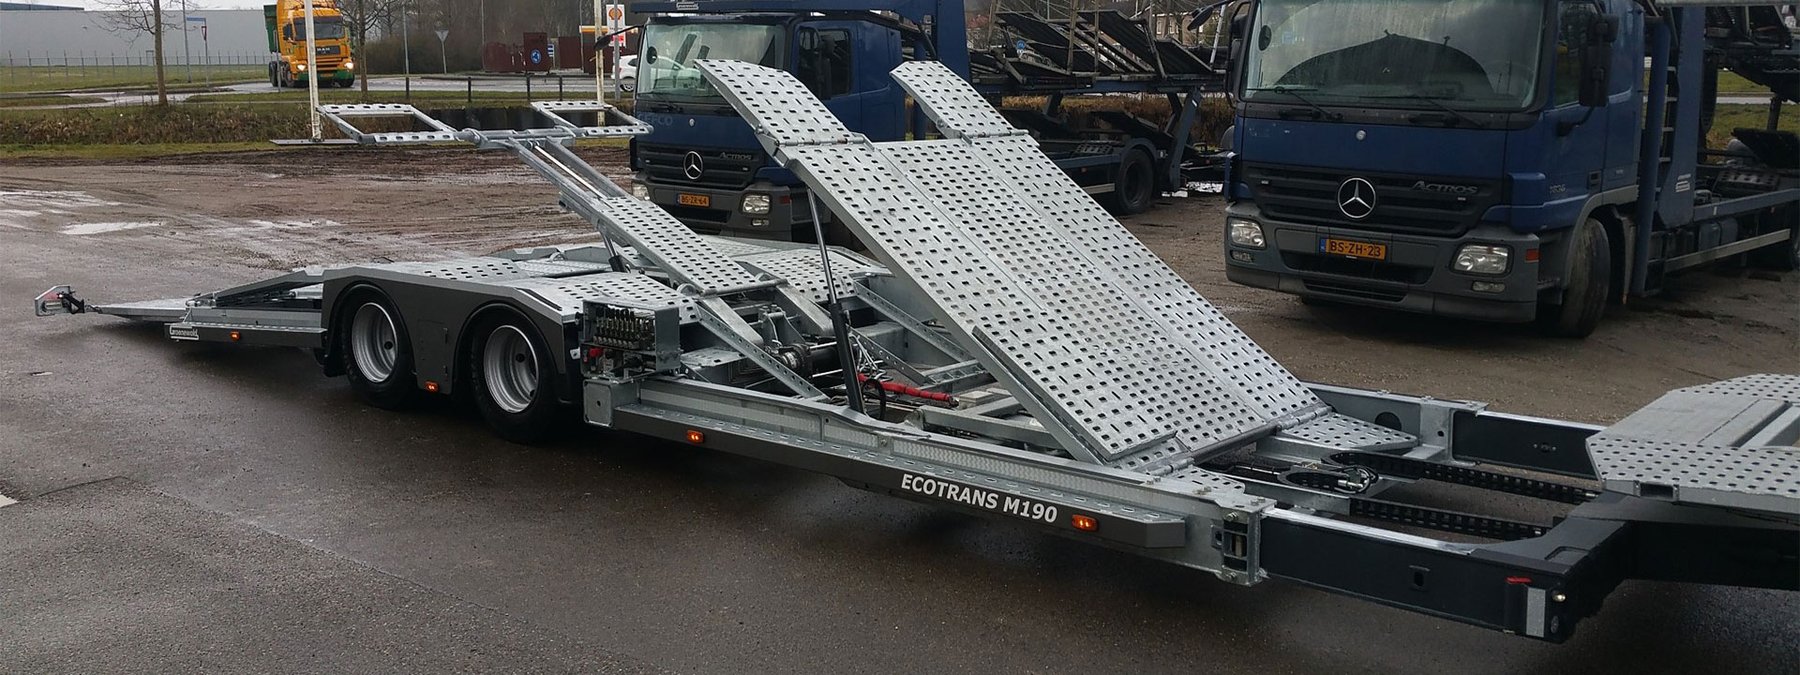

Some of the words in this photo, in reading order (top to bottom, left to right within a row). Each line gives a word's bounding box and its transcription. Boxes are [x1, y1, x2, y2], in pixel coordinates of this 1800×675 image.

[1330, 241, 1381, 257] BS-ZH-23
[901, 473, 998, 509] ECOTRANS
[1003, 496, 1058, 523] M190
